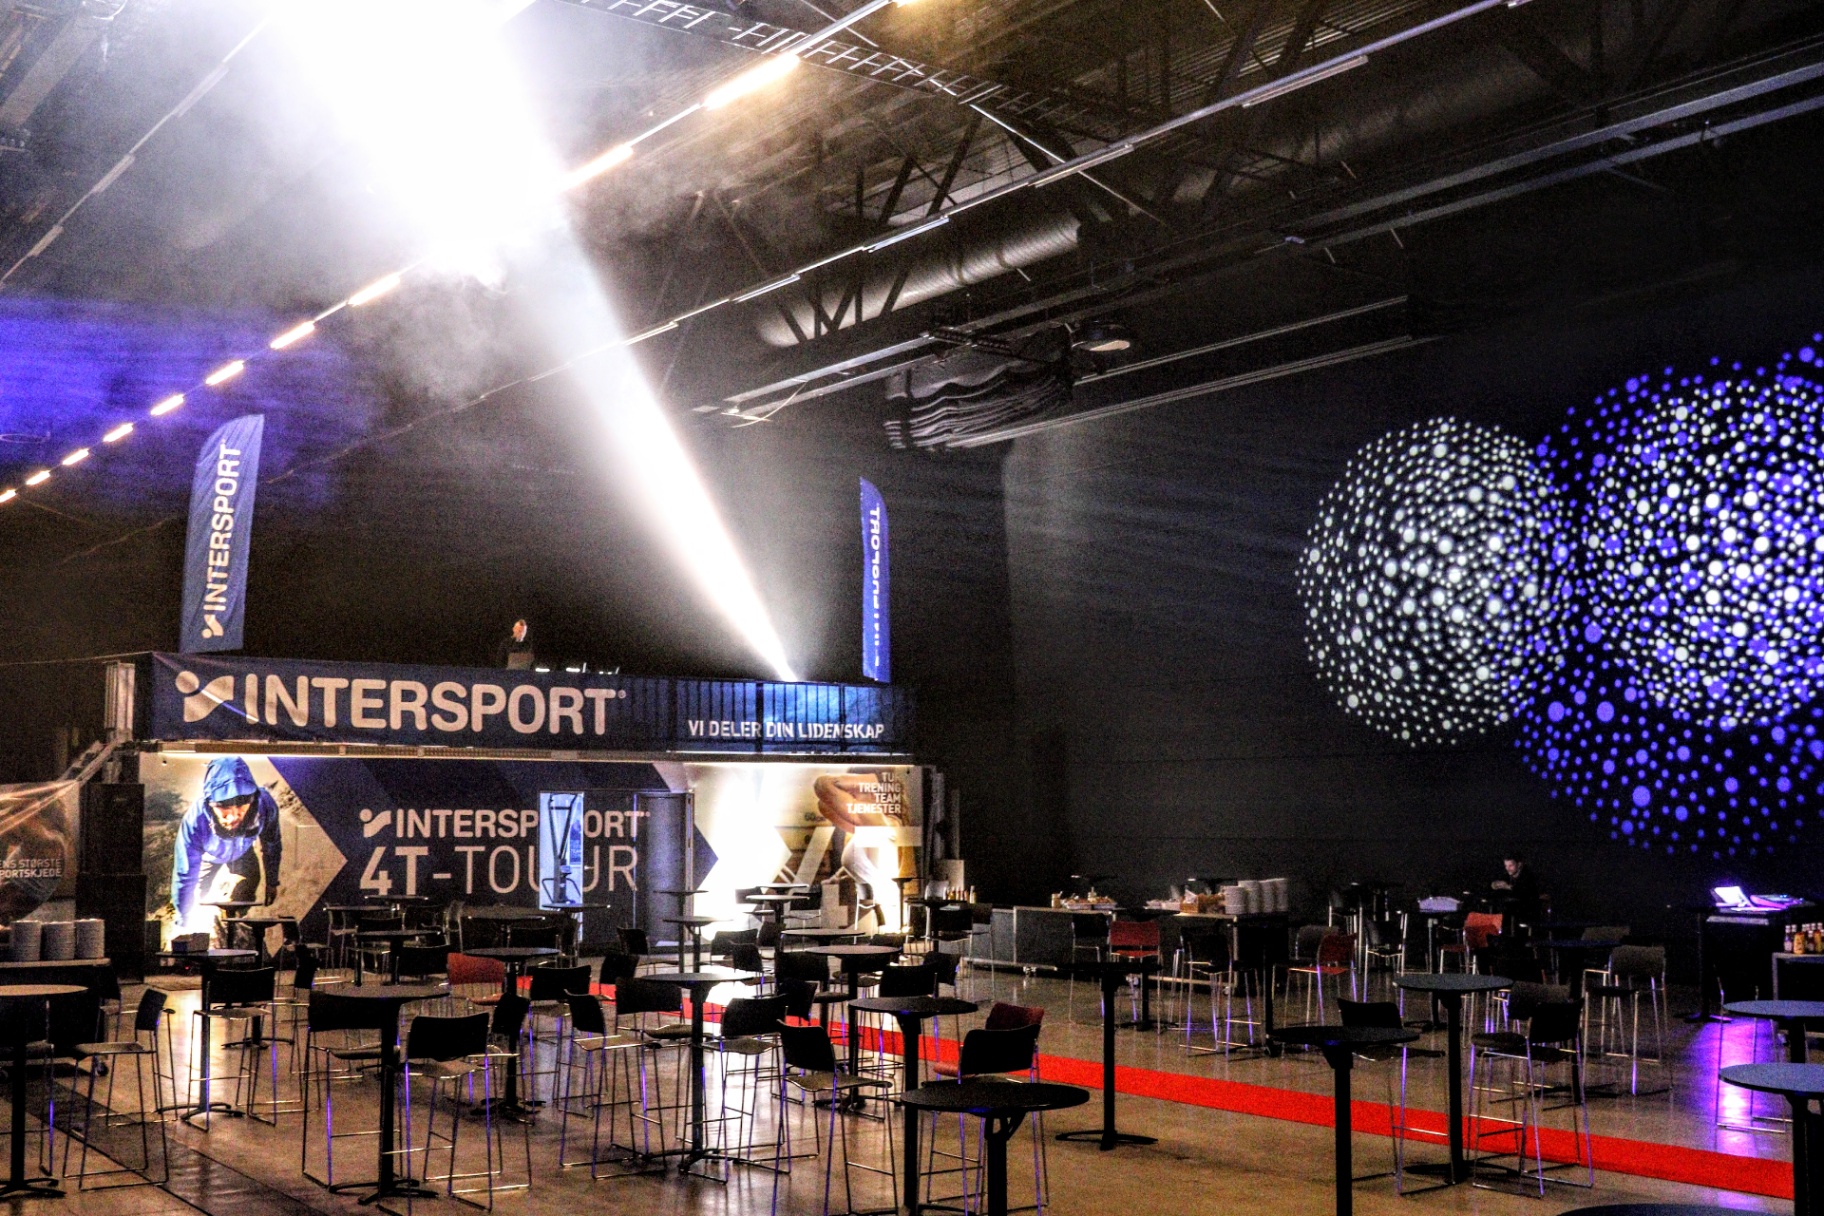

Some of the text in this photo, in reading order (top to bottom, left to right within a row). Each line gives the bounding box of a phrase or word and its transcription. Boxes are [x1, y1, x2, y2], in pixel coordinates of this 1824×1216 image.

[203, 443, 241, 612] INTERSPORT
[245, 673, 616, 735] INTERSPORT
[688, 720, 885, 739] VI DELER DIN LIDENSKAP
[858, 782, 901, 793] TRENING
[874, 793, 901, 803] TEAM
